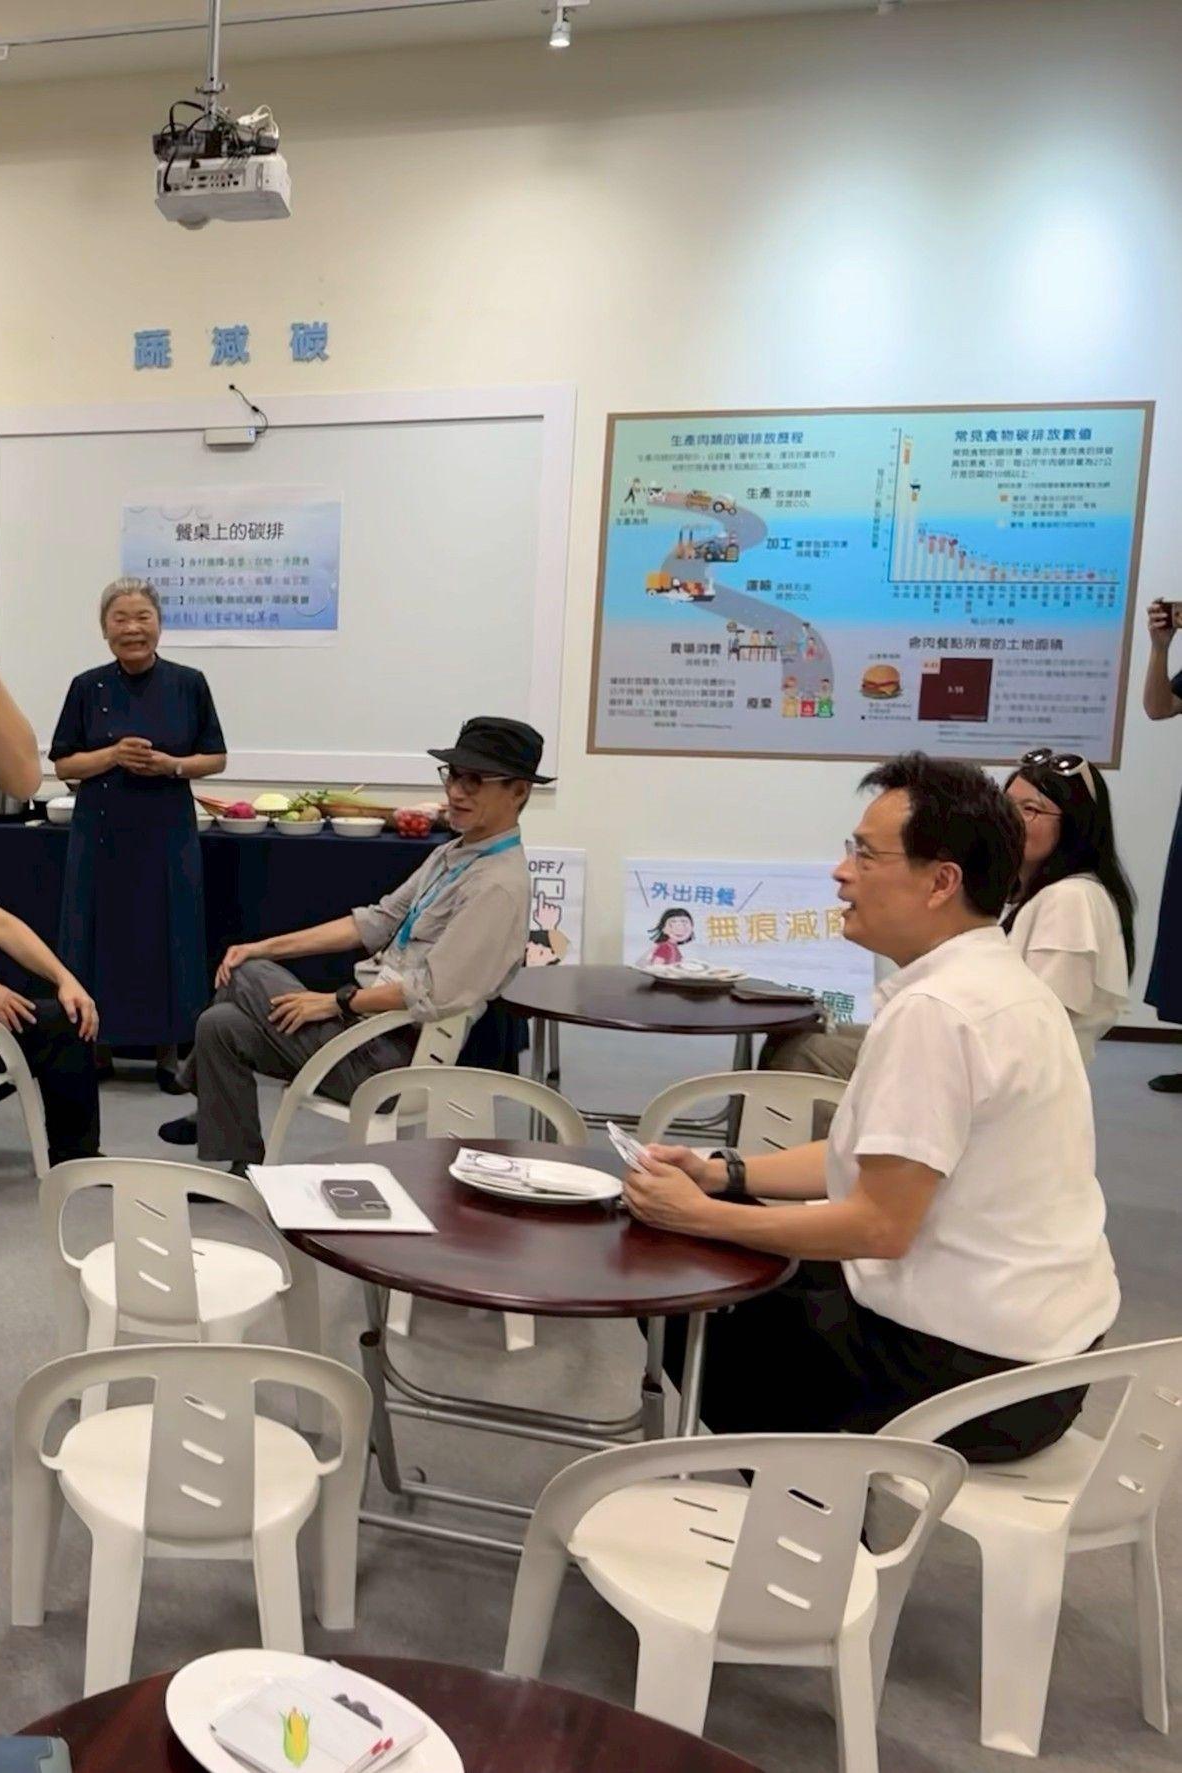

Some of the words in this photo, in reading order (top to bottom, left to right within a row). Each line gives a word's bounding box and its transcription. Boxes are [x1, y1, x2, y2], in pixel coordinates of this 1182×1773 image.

[954, 428, 1093, 442] 常見食物碳排放數值
[746, 487, 772, 499] 生產
[175, 522, 286, 542] 餐桌上的碳排
[766, 538, 792, 550] 加工
[650, 881, 737, 907] 外出用餐
